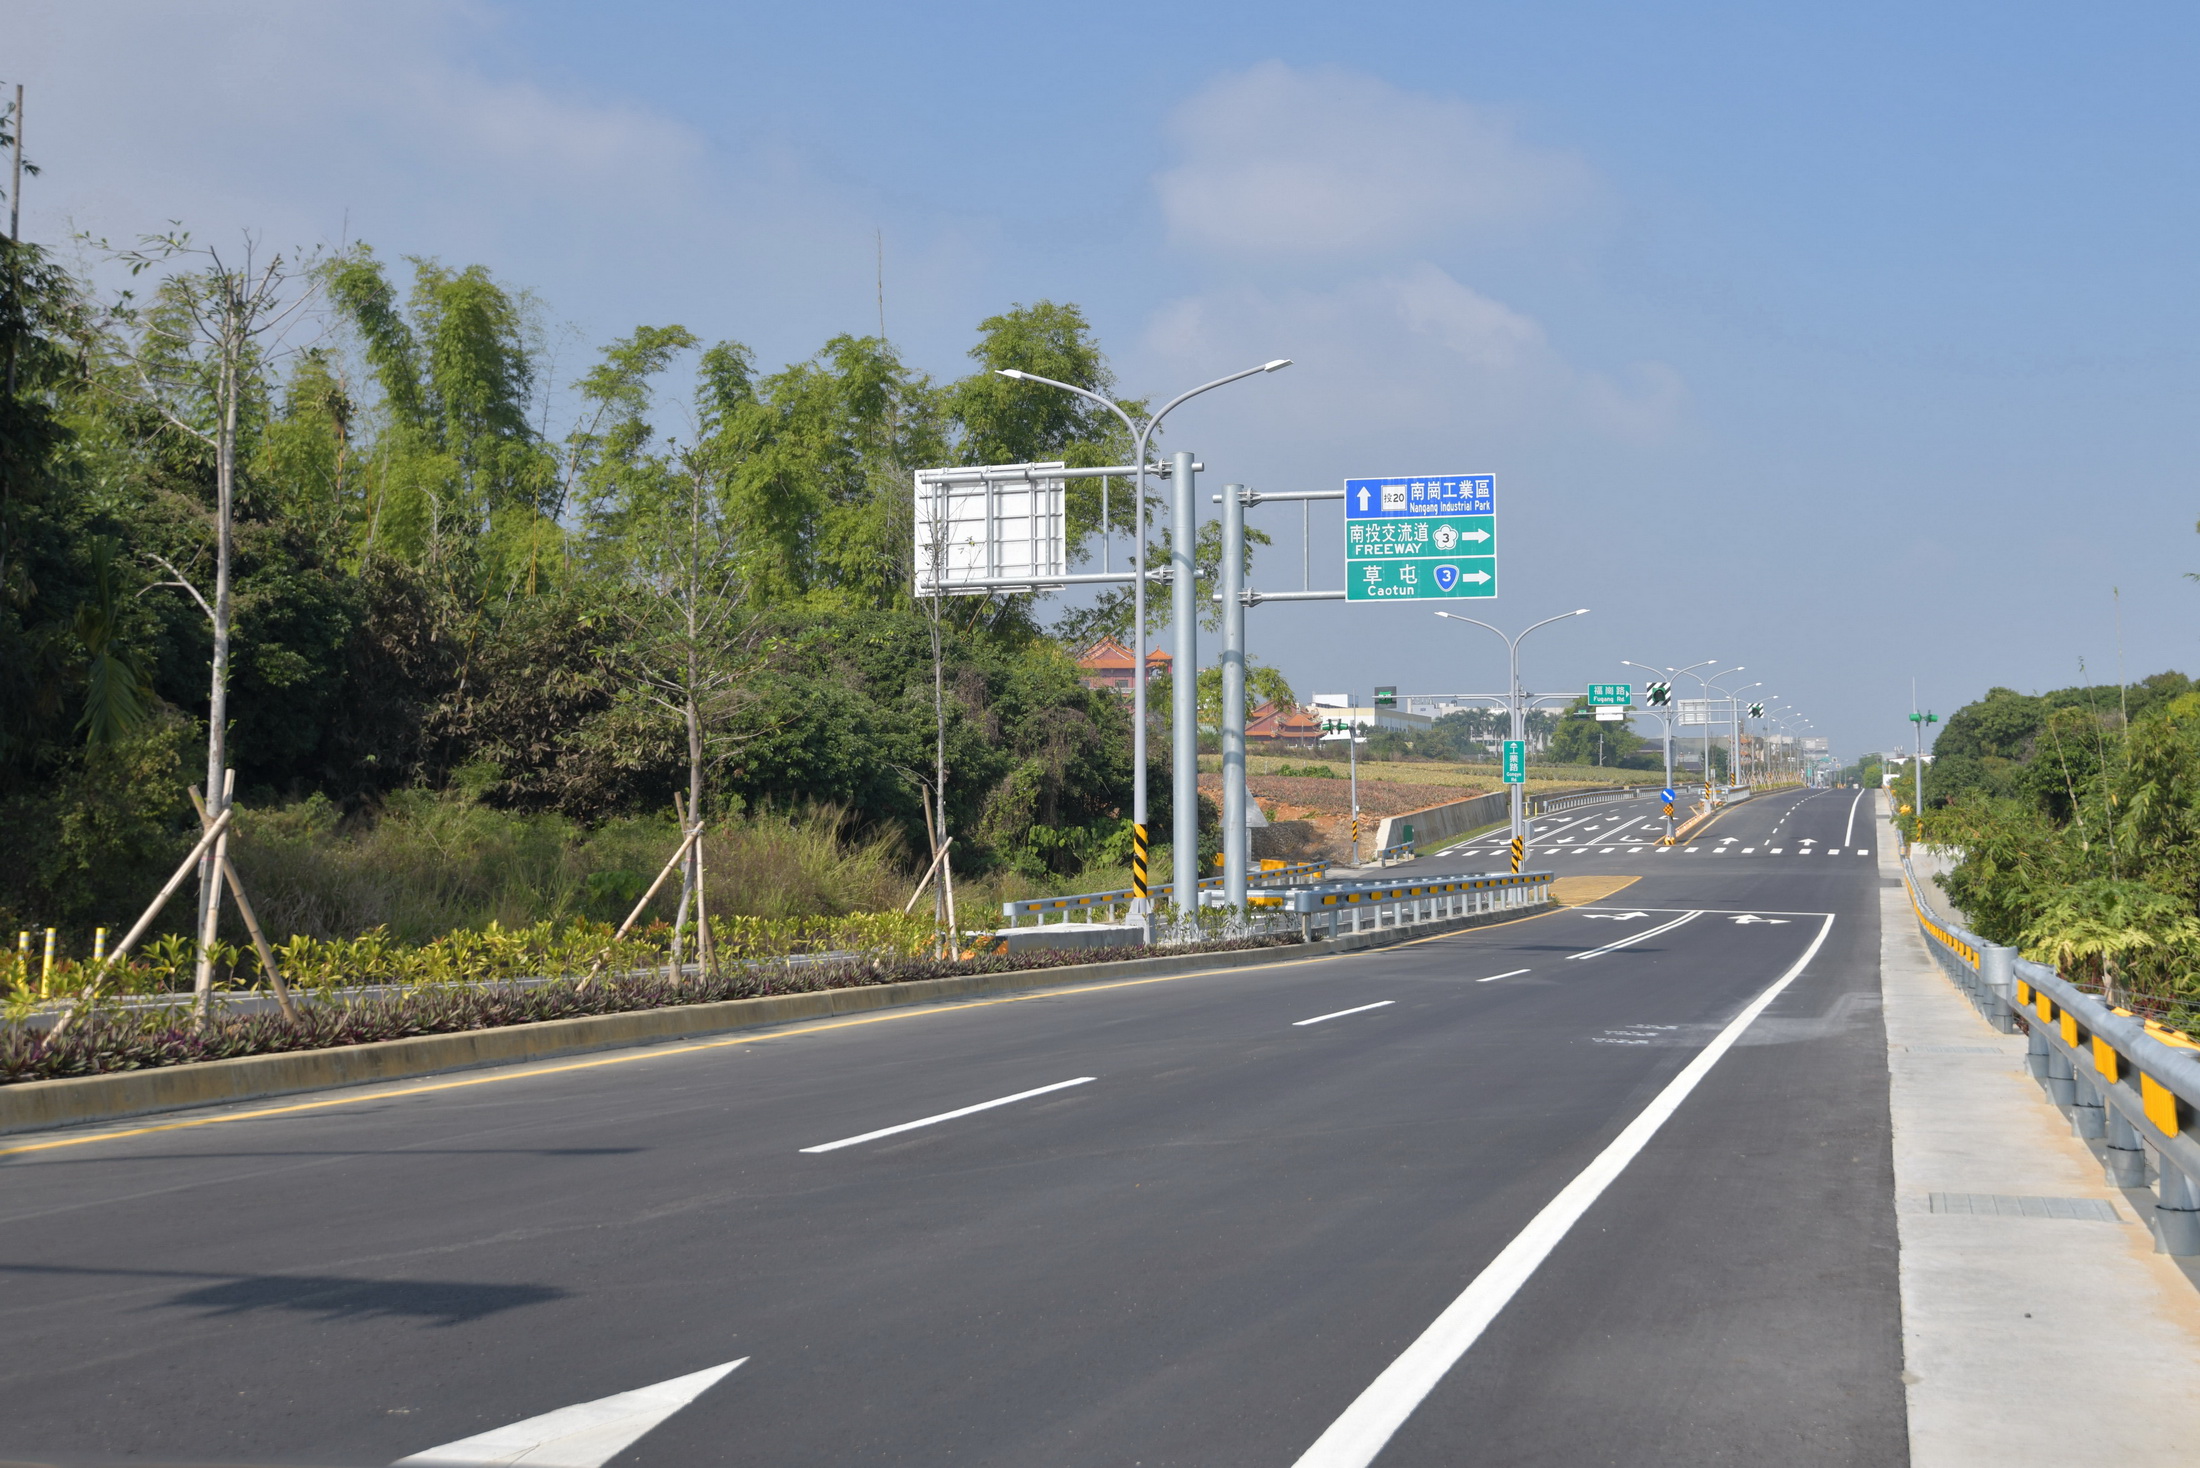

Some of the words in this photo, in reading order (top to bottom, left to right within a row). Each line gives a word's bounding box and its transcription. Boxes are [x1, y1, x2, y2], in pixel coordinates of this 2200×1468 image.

[1410, 479, 1490, 501] 南崗工業區
[1384, 493, 1404, 503] 投20
[1410, 502, 1438, 515] Nangang
[1440, 501, 1472, 512] Industrial
[1474, 500, 1490, 511] Park
[1350, 522, 1429, 543] 南投交流道
[1442, 533, 1450, 543] 3
[1355, 543, 1422, 555] FREEWAY
[1442, 570, 1451, 582] 3
[1367, 585, 1415, 596] Caotun
[1509, 747, 1519, 771] 工業路
